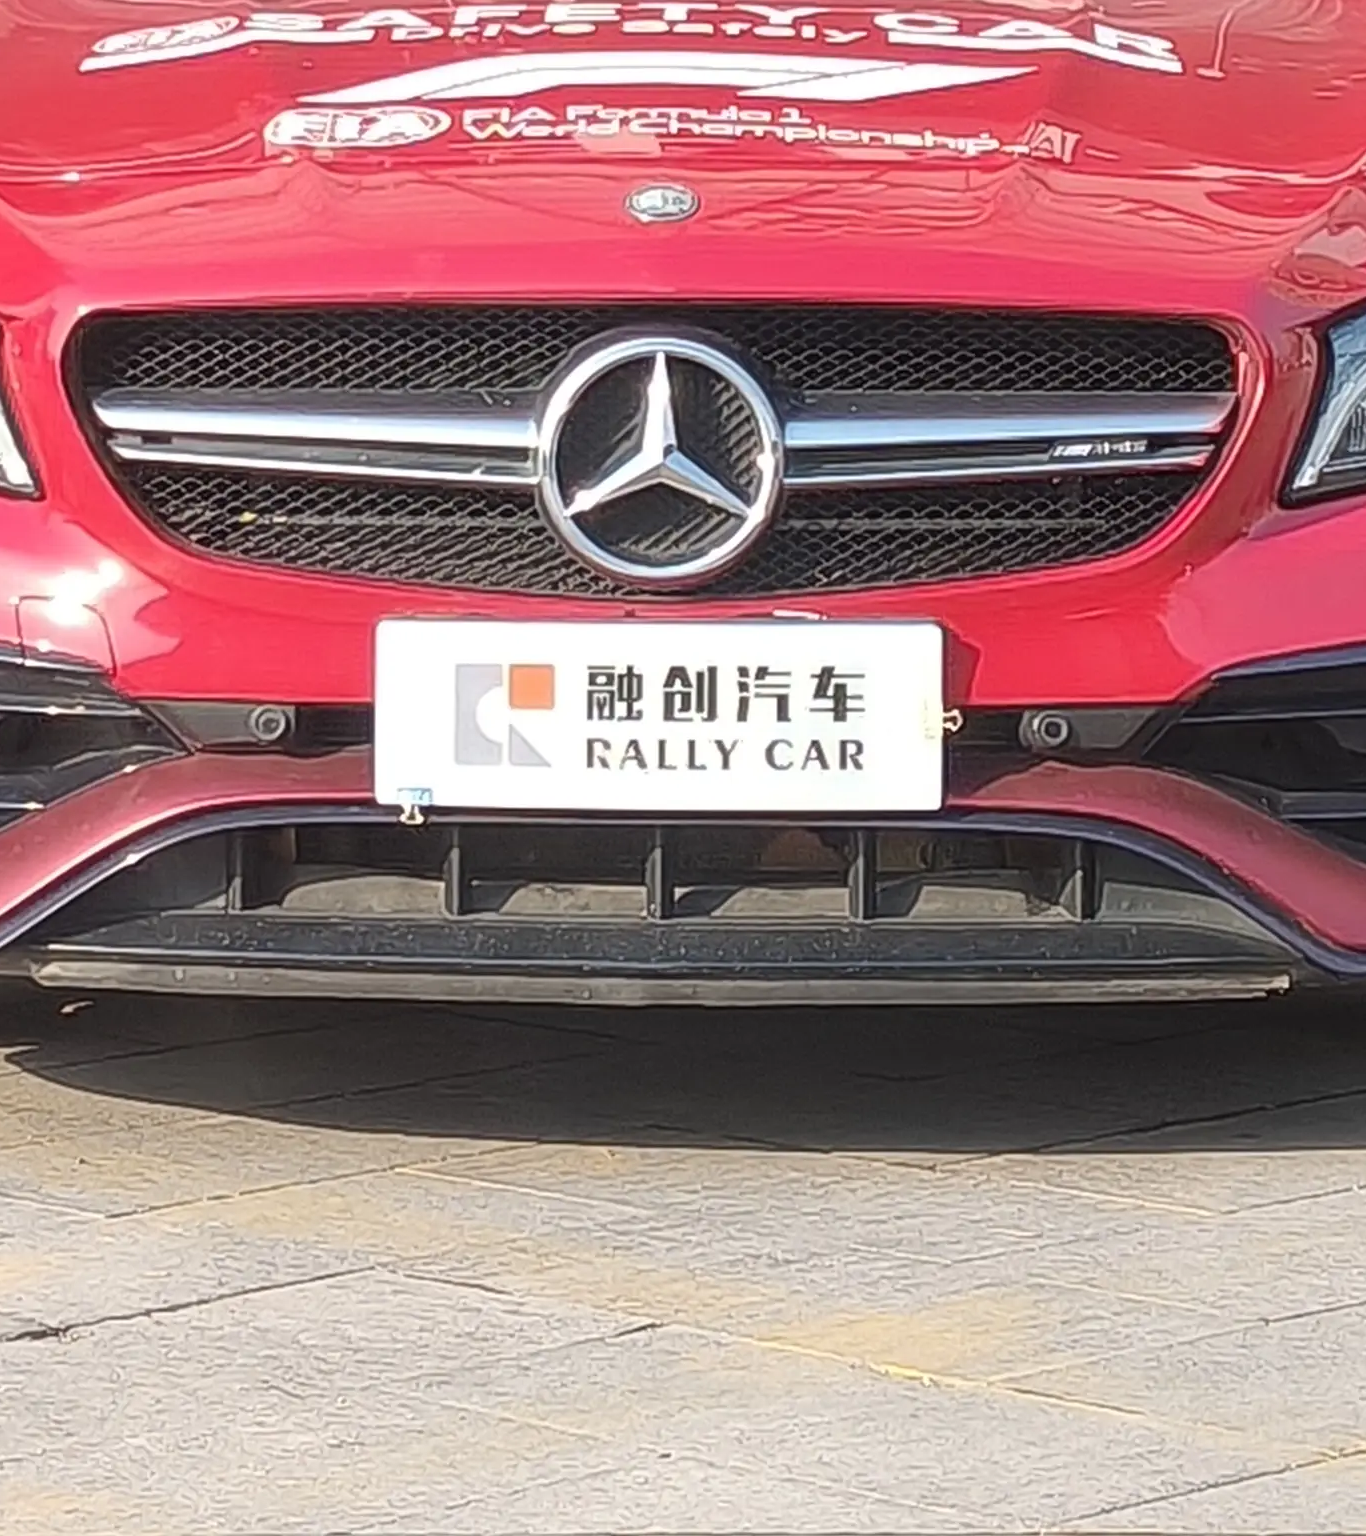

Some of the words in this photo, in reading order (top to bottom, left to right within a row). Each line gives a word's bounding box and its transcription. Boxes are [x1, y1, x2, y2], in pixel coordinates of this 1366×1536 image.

[243, 2, 833, 32] SAFETY
[873, 13, 1181, 63] CAR
[462, 106, 551, 122] FIA
[565, 105, 774, 123] Formula
[777, 106, 813, 124] 1
[464, 119, 620, 140] World
[629, 120, 1001, 157] Championship
[585, 665, 866, 724] 融创汽车
[585, 738, 740, 772] RALLY
[765, 738, 866, 772] CAR
